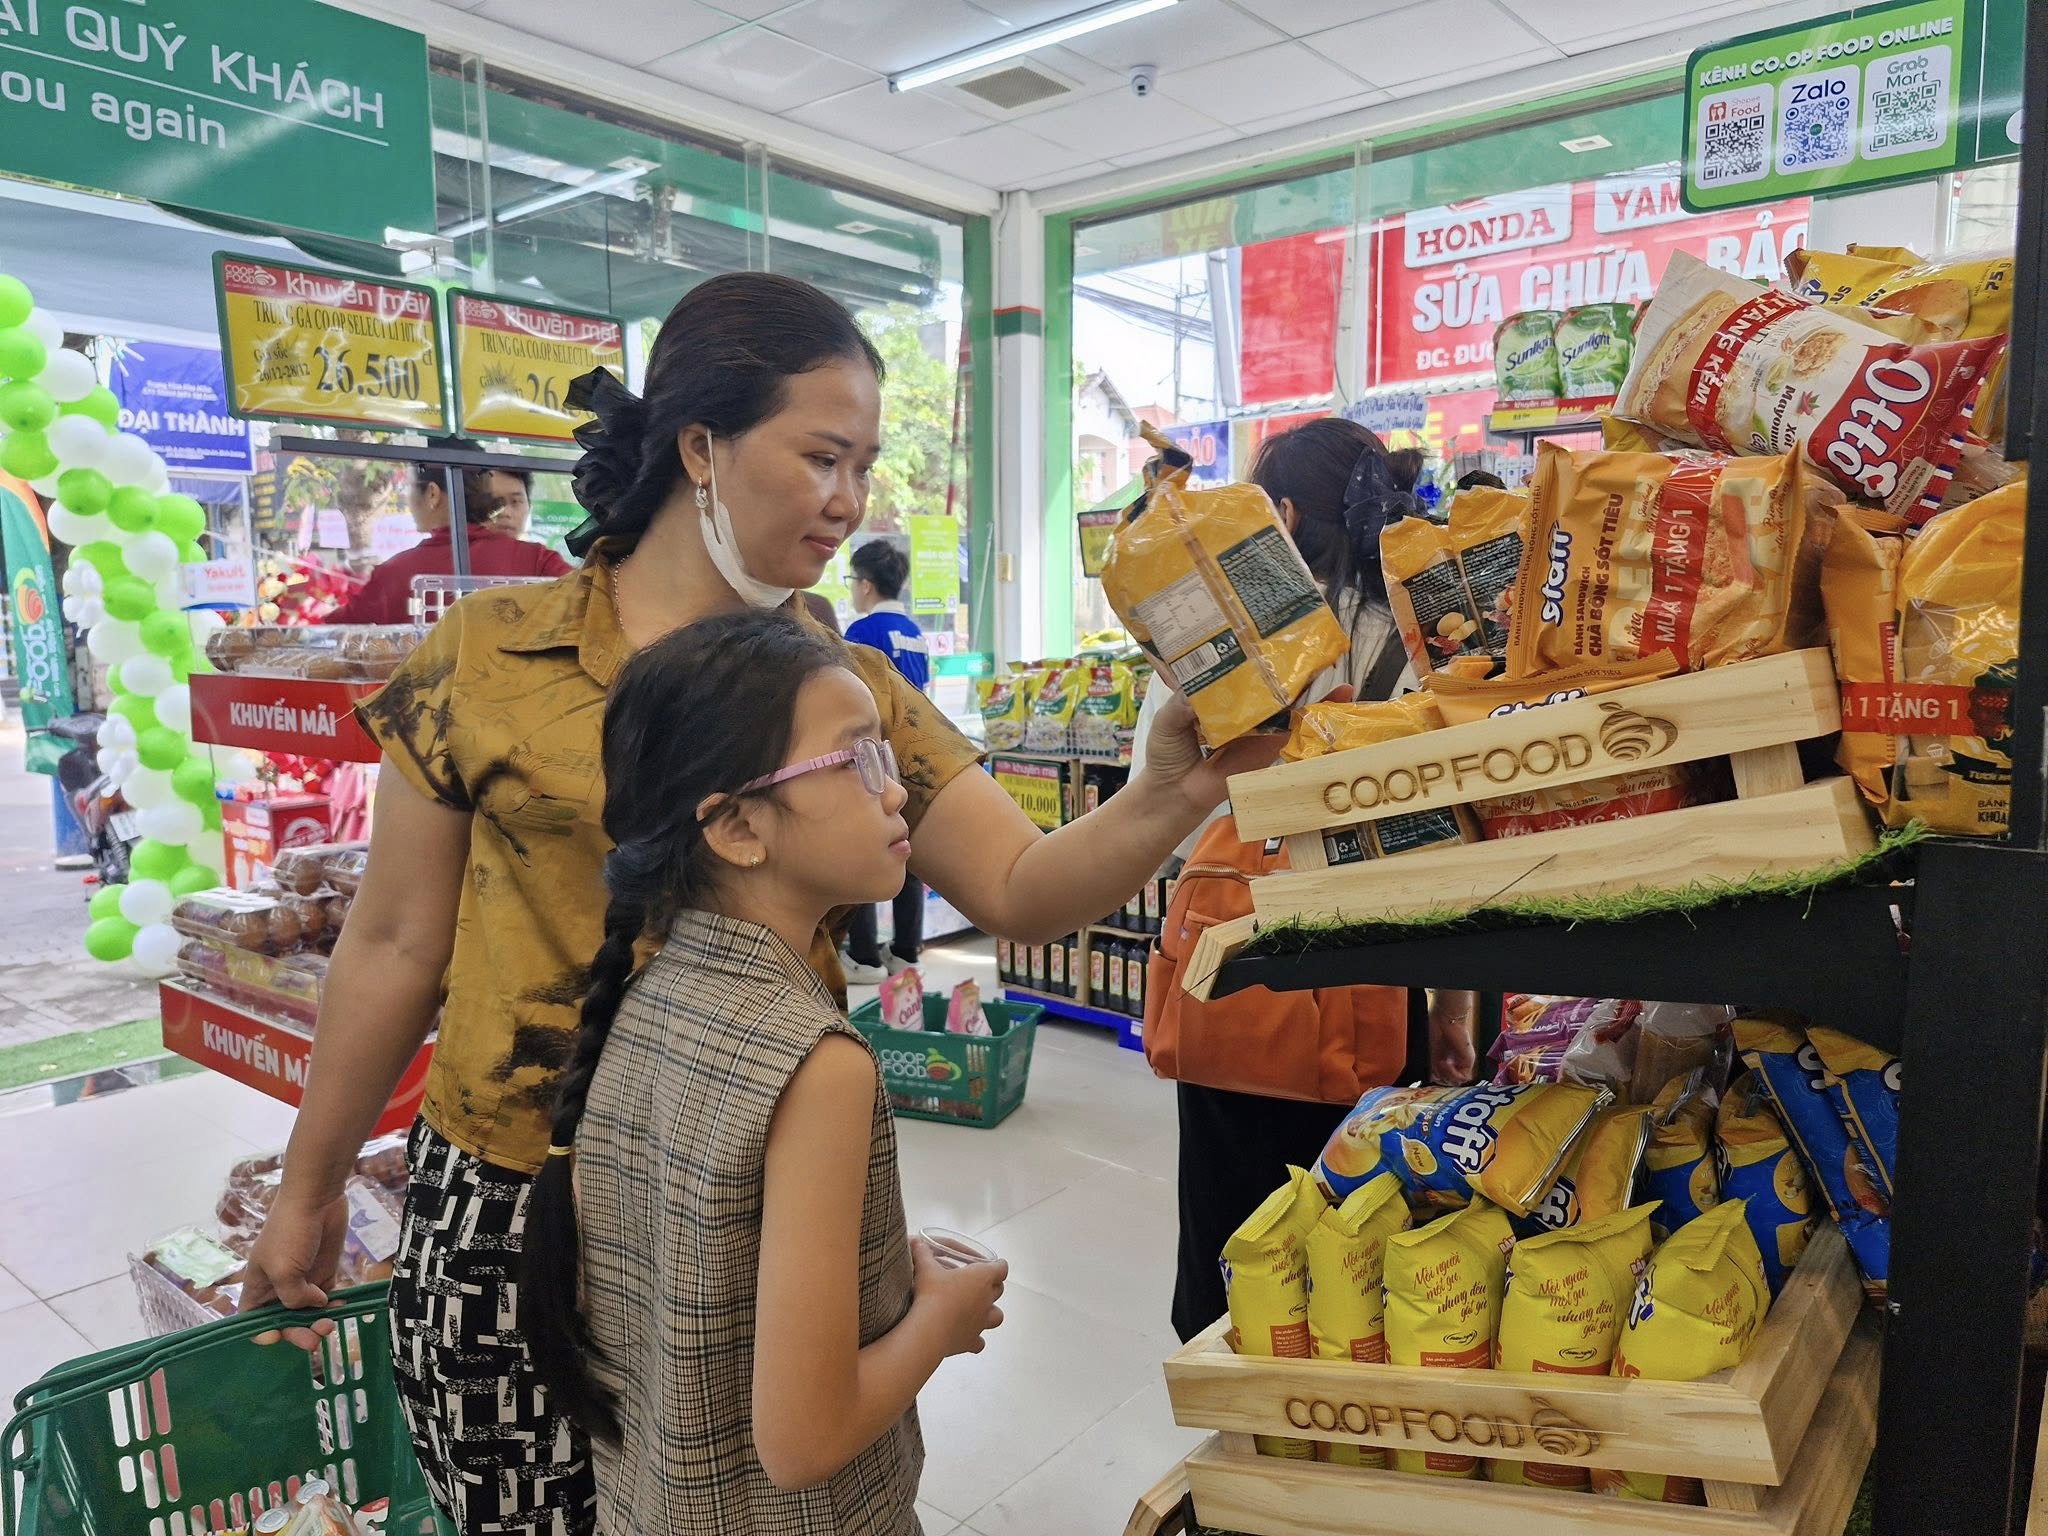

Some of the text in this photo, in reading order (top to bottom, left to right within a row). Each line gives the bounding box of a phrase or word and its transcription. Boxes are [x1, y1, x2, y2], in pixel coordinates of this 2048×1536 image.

[66, 5, 187, 71] QUÝ
[211, 43, 385, 129] KHÁCH
[1700, 16, 1953, 88] KÊNH CO.OP FOOD ONLINE
[1887, 55, 1929, 75] Grab
[1790, 79, 1847, 104] Zalo
[1886, 71, 1928, 89] Mart
[91, 90, 226, 148] again
[1731, 103, 1761, 117] Food
[1417, 207, 1555, 259] HONDA
[1412, 263, 1503, 333] SỬA
[1519, 243, 1651, 313] CHỮA
[1561, 331, 1611, 368] Sunlight
[313, 346, 420, 401] 26.500
[117, 408, 246, 437] ĐẠI THÀNH
[1826, 357, 1932, 477] Otto
[203, 566, 245, 580] Yakult
[1540, 519, 1573, 628] Staff
[1588, 493, 1624, 658] CHÀ BÔNG SỐT TIÊU
[1655, 508, 1693, 644] MUA 1 TẶNG 1
[1517, 571, 1529, 623] SANDWICH
[1574, 566, 1591, 657] BÁNH SANDWICH
[230, 697, 337, 737] KHUYẾN MÃI
[1859, 696, 1870, 717] 1
[1875, 691, 1941, 722] TẶNG
[1947, 698, 1960, 721] 1
[1323, 733, 1593, 816] CO.OP FOOD
[1021, 793, 1057, 814] 10.000
[202, 1020, 280, 1078] KHUYẾN
[880, 1049, 926, 1064] COOP
[881, 1062, 929, 1078] FOOD
[1412, 1147, 1425, 1168] New
[1436, 1251, 1460, 1277] người
[1562, 1265, 1590, 1292] người
[1426, 1277, 1446, 1300] một
[1285, 1397, 1526, 1450] CO.OP FOOD
